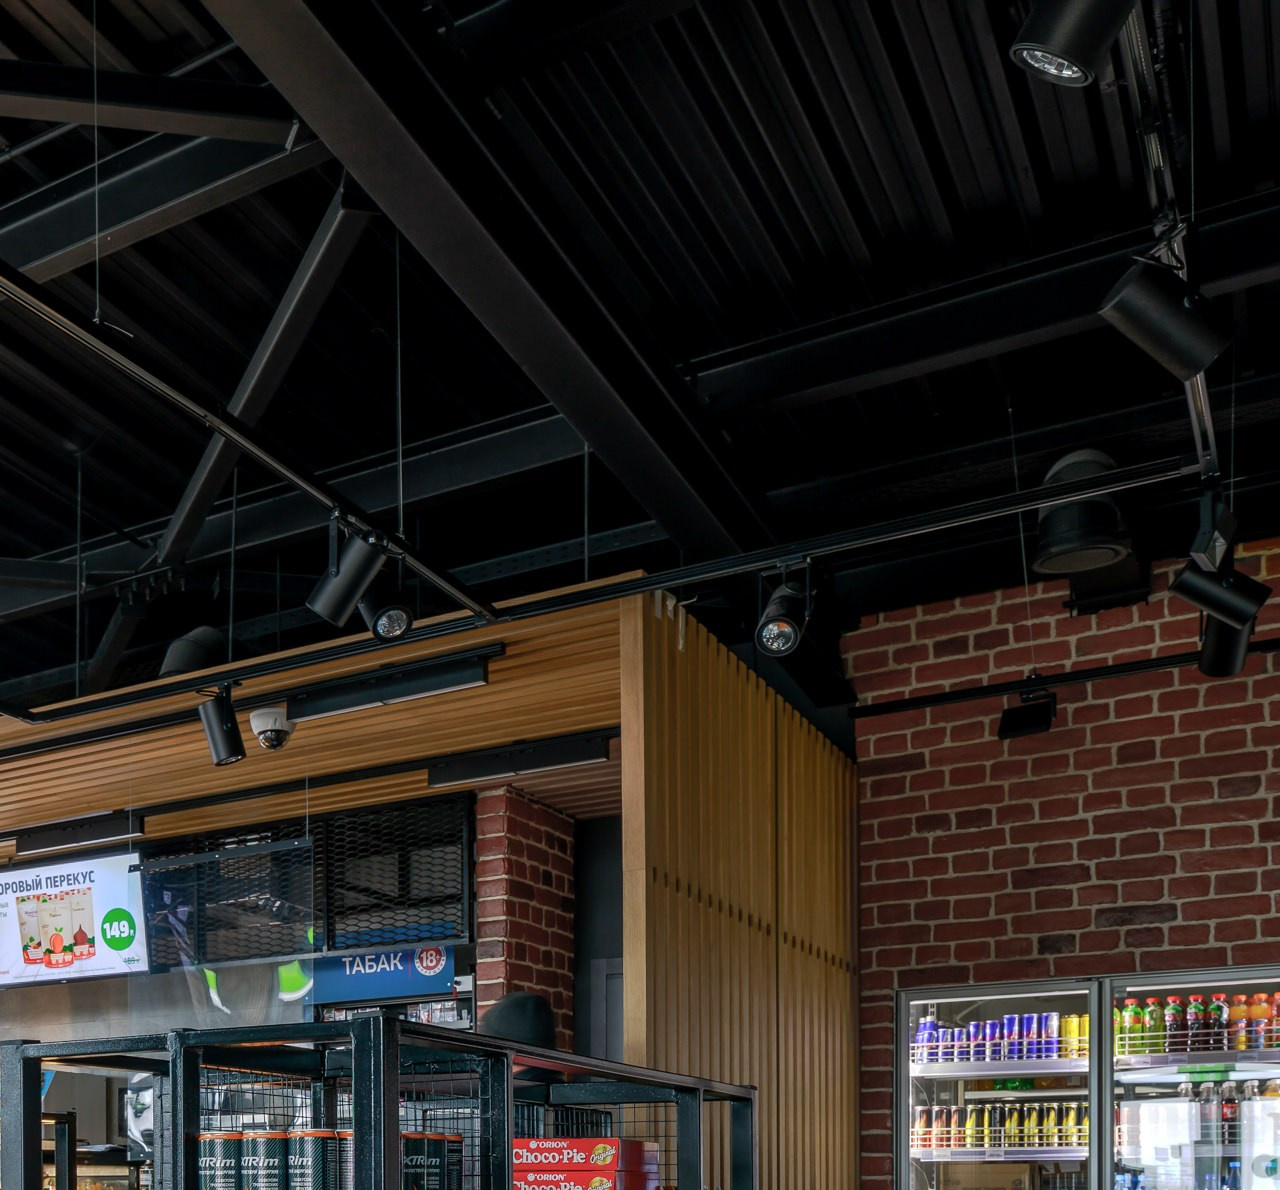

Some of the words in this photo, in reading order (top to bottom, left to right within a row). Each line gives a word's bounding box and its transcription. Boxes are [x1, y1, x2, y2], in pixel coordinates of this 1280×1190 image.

[45, 870, 96, 890] ПЕРЕКУС
[342, 952, 403, 976] ТАБАК
[420, 950, 440, 967] 18+
[538, 1140, 569, 1148] ORION
[288, 1155, 312, 1166] Rim
[589, 1146, 617, 1165] Original
[535, 1173, 566, 1181] ORION
